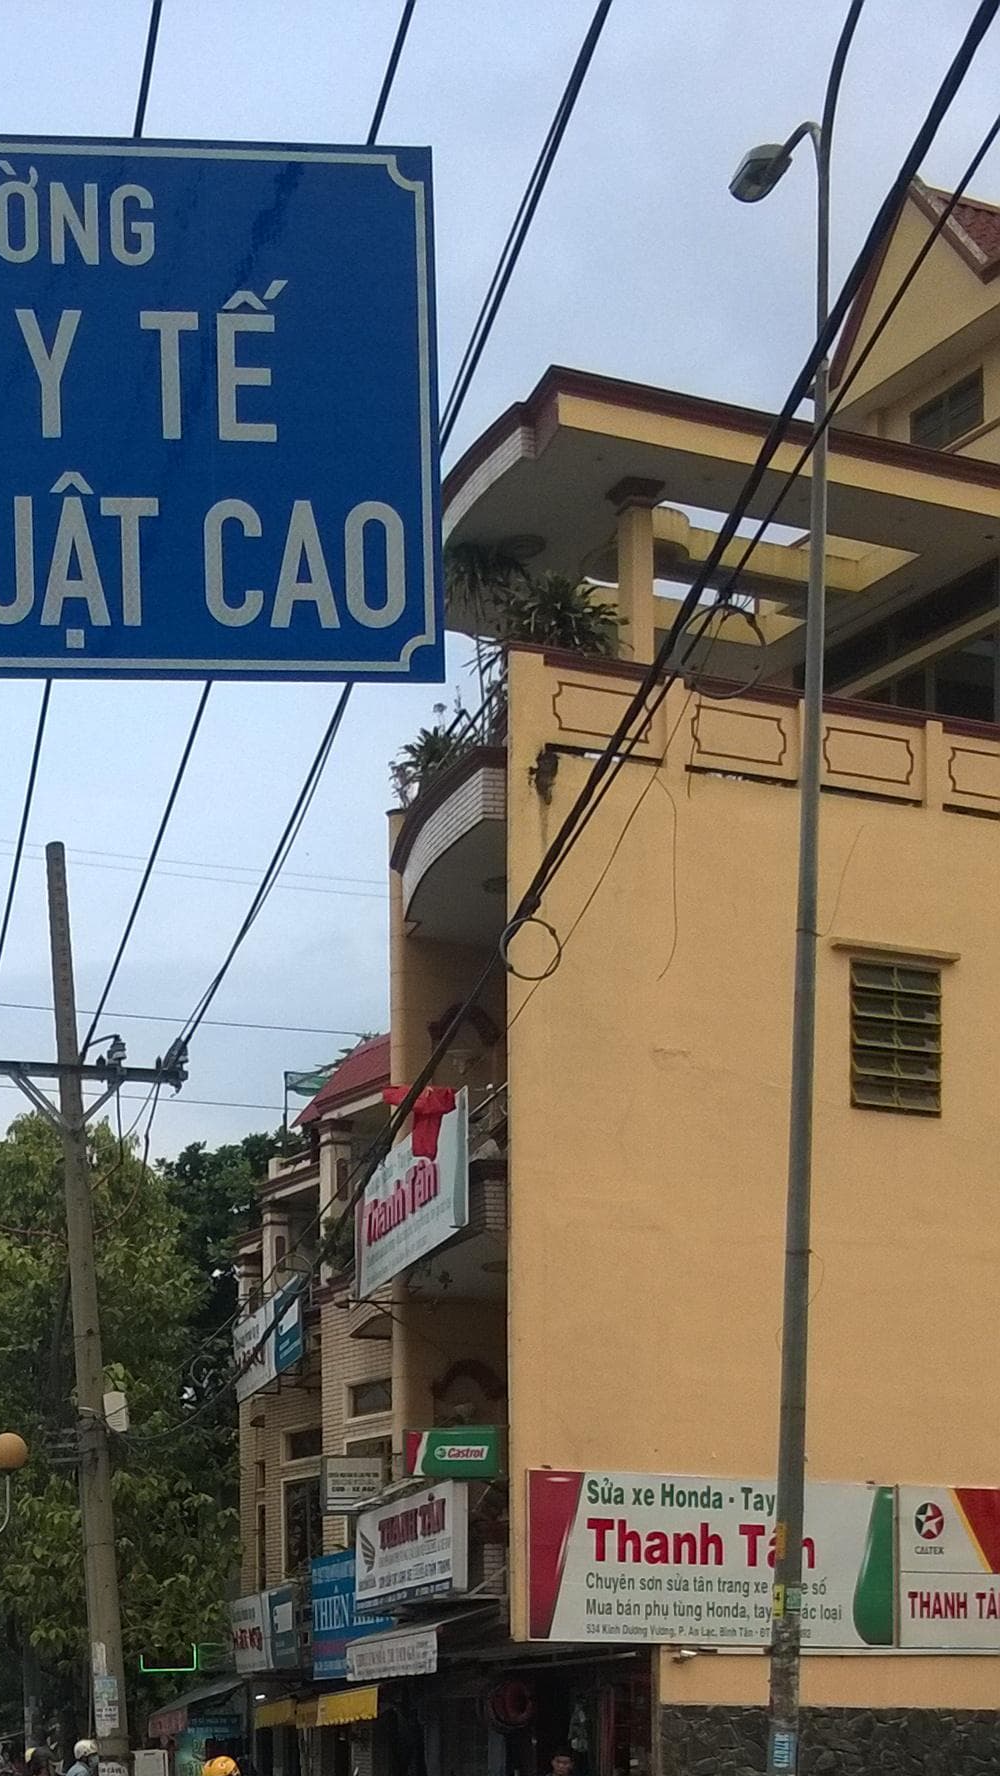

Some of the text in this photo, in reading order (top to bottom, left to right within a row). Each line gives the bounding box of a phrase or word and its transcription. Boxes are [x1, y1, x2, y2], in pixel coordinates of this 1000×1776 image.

[15, 308, 82, 439] Y
[140, 280, 288, 443] TẾ
[204, 499, 406, 629] CAO
[447, 1448, 484, 1459] Castrol
[587, 1477, 624, 1505] Sửa
[632, 1487, 655, 1506] xe
[661, 1483, 723, 1509] Honda
[740, 1487, 776, 1517] Tay
[587, 1517, 723, 1566] Thanh
[914, 1546, 944, 1555] CALTEX
[586, 1572, 635, 1594] Chuyên
[693, 1576, 713, 1592] tân
[717, 1577, 749, 1597] trang
[754, 1581, 768, 1593] xe
[812, 1577, 827, 1595] số
[586, 1599, 612, 1616] Mua
[617, 1599, 640, 1616] bán
[645, 1600, 669, 1620] phụ
[673, 1600, 702, 1621] tùng
[706, 1601, 750, 1620] Honda,
[754, 1604, 772, 1623] tay
[820, 1604, 842, 1624] loại
[908, 1587, 1000, 1619] THANH TÂ
